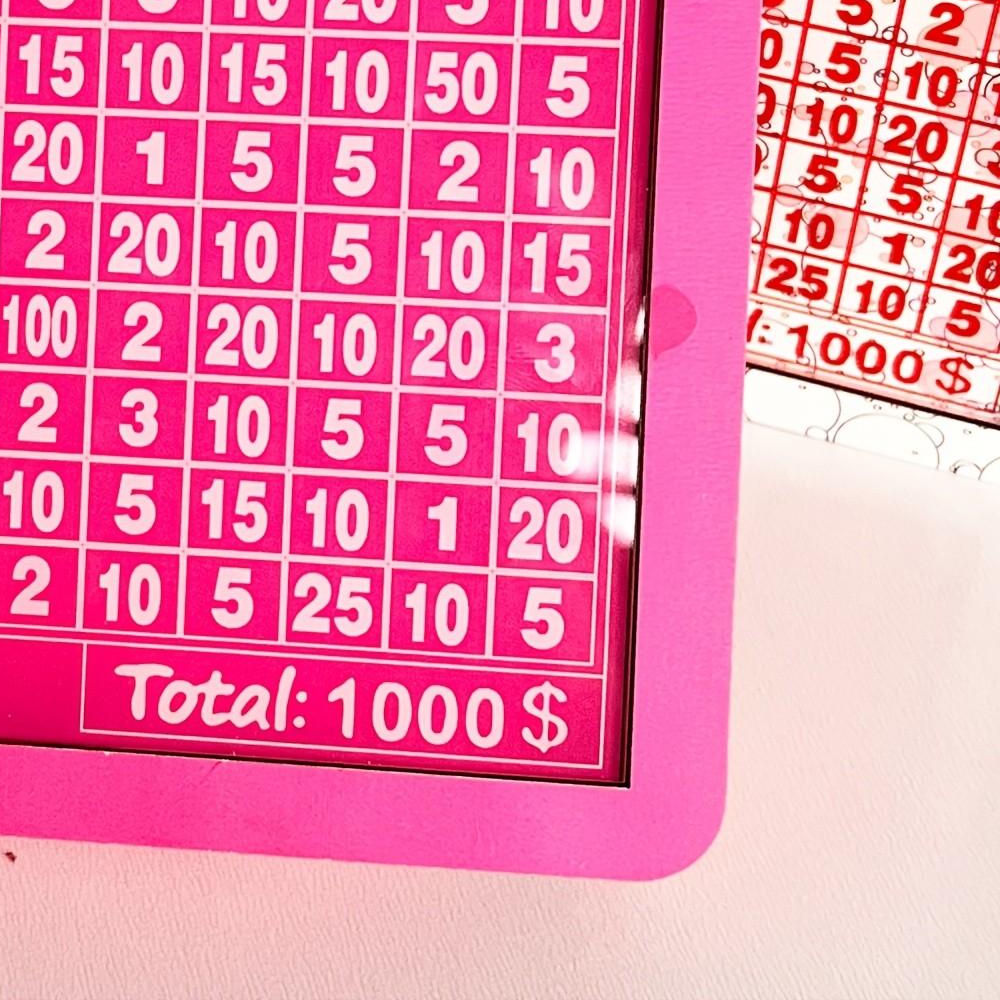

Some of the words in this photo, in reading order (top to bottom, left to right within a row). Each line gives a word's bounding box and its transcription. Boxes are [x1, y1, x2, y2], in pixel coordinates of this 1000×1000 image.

[922, 1, 966, 48] 2
[18, 34, 85, 98] 15
[121, 42, 185, 105] 10
[220, 42, 288, 106] 15
[325, 49, 390, 114] 10
[424, 51, 498, 116] 50
[545, 55, 590, 119] 5
[824, 41, 863, 85] 5
[903, 60, 959, 107] 10
[11, 119, 84, 186] 20
[136, 131, 165, 185] 1
[230, 130, 273, 193] 5
[332, 134, 377, 198] 5
[436, 140, 481, 203] 2
[529, 147, 595, 211] 10
[804, 98, 859, 145] 10
[882, 114, 950, 164] 20
[801, 154, 841, 195] 5
[887, 173, 926, 216] 5
[24, 209, 66, 270] 2
[107, 211, 181, 277] 20
[215, 220, 278, 284] 10
[328, 222, 372, 285] 5
[420, 230, 485, 294] 10
[523, 231, 592, 297] 15
[785, 207, 837, 251] 10
[882, 232, 908, 265] 1
[942, 243, 1000, 293] 20
[764, 256, 830, 302] 25
[855, 279, 907, 322] 10
[944, 299, 983, 339] 5
[787, 324, 925, 385] 1000
[10, 555, 51, 616] 2
[99, 563, 162, 626] 10
[211, 566, 254, 629] 5
[291, 572, 373, 637] 25
[405, 582, 469, 647] 10
[520, 586, 565, 650] 5
[114, 663, 308, 732] Total:
[327, 677, 505, 749] 1000
[521, 680, 568, 753] $
